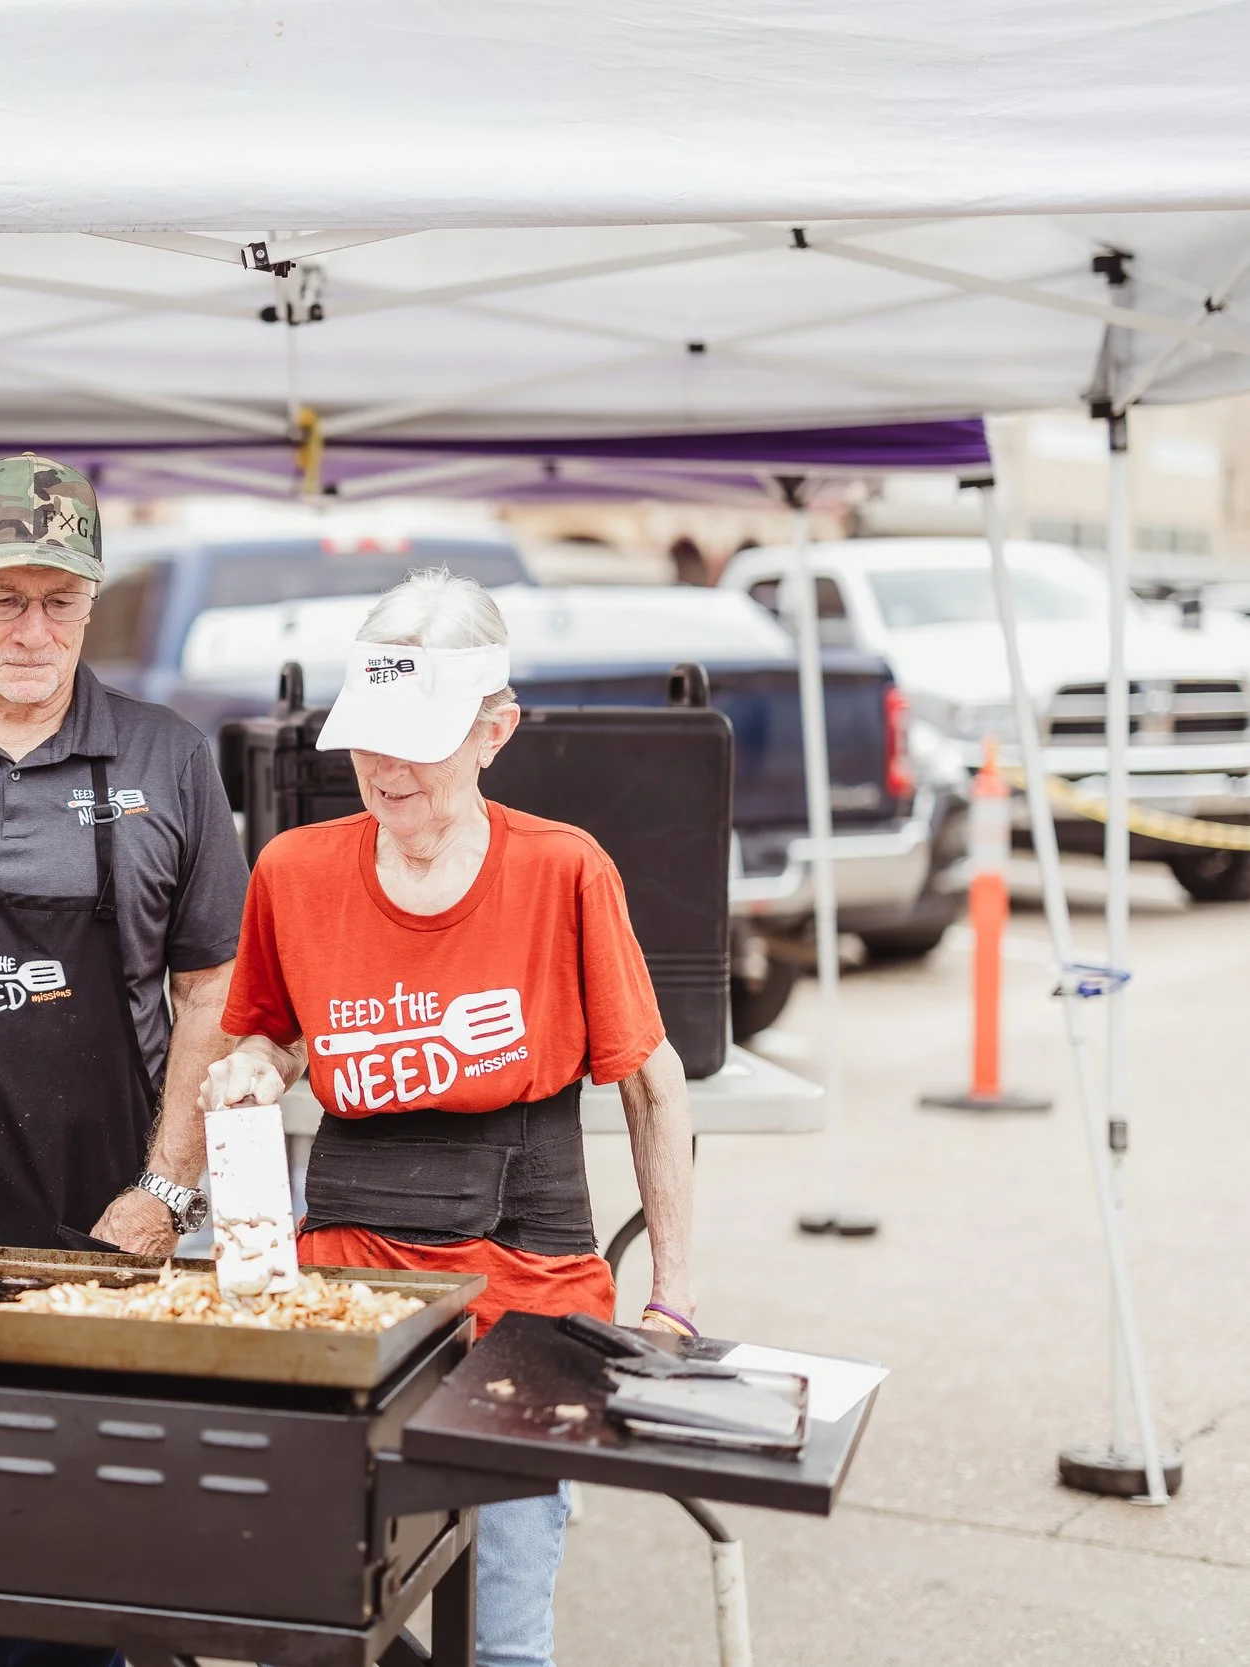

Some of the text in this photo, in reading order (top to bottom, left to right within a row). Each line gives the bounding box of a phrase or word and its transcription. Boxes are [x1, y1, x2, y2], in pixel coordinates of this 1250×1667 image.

[369, 670, 399, 684] NEED
[72, 789, 95, 800] FEED
[31, 988, 72, 1004] missions
[329, 998, 385, 1029] FEED
[464, 1045, 529, 1078] missions
[333, 1042, 459, 1113] NEED
